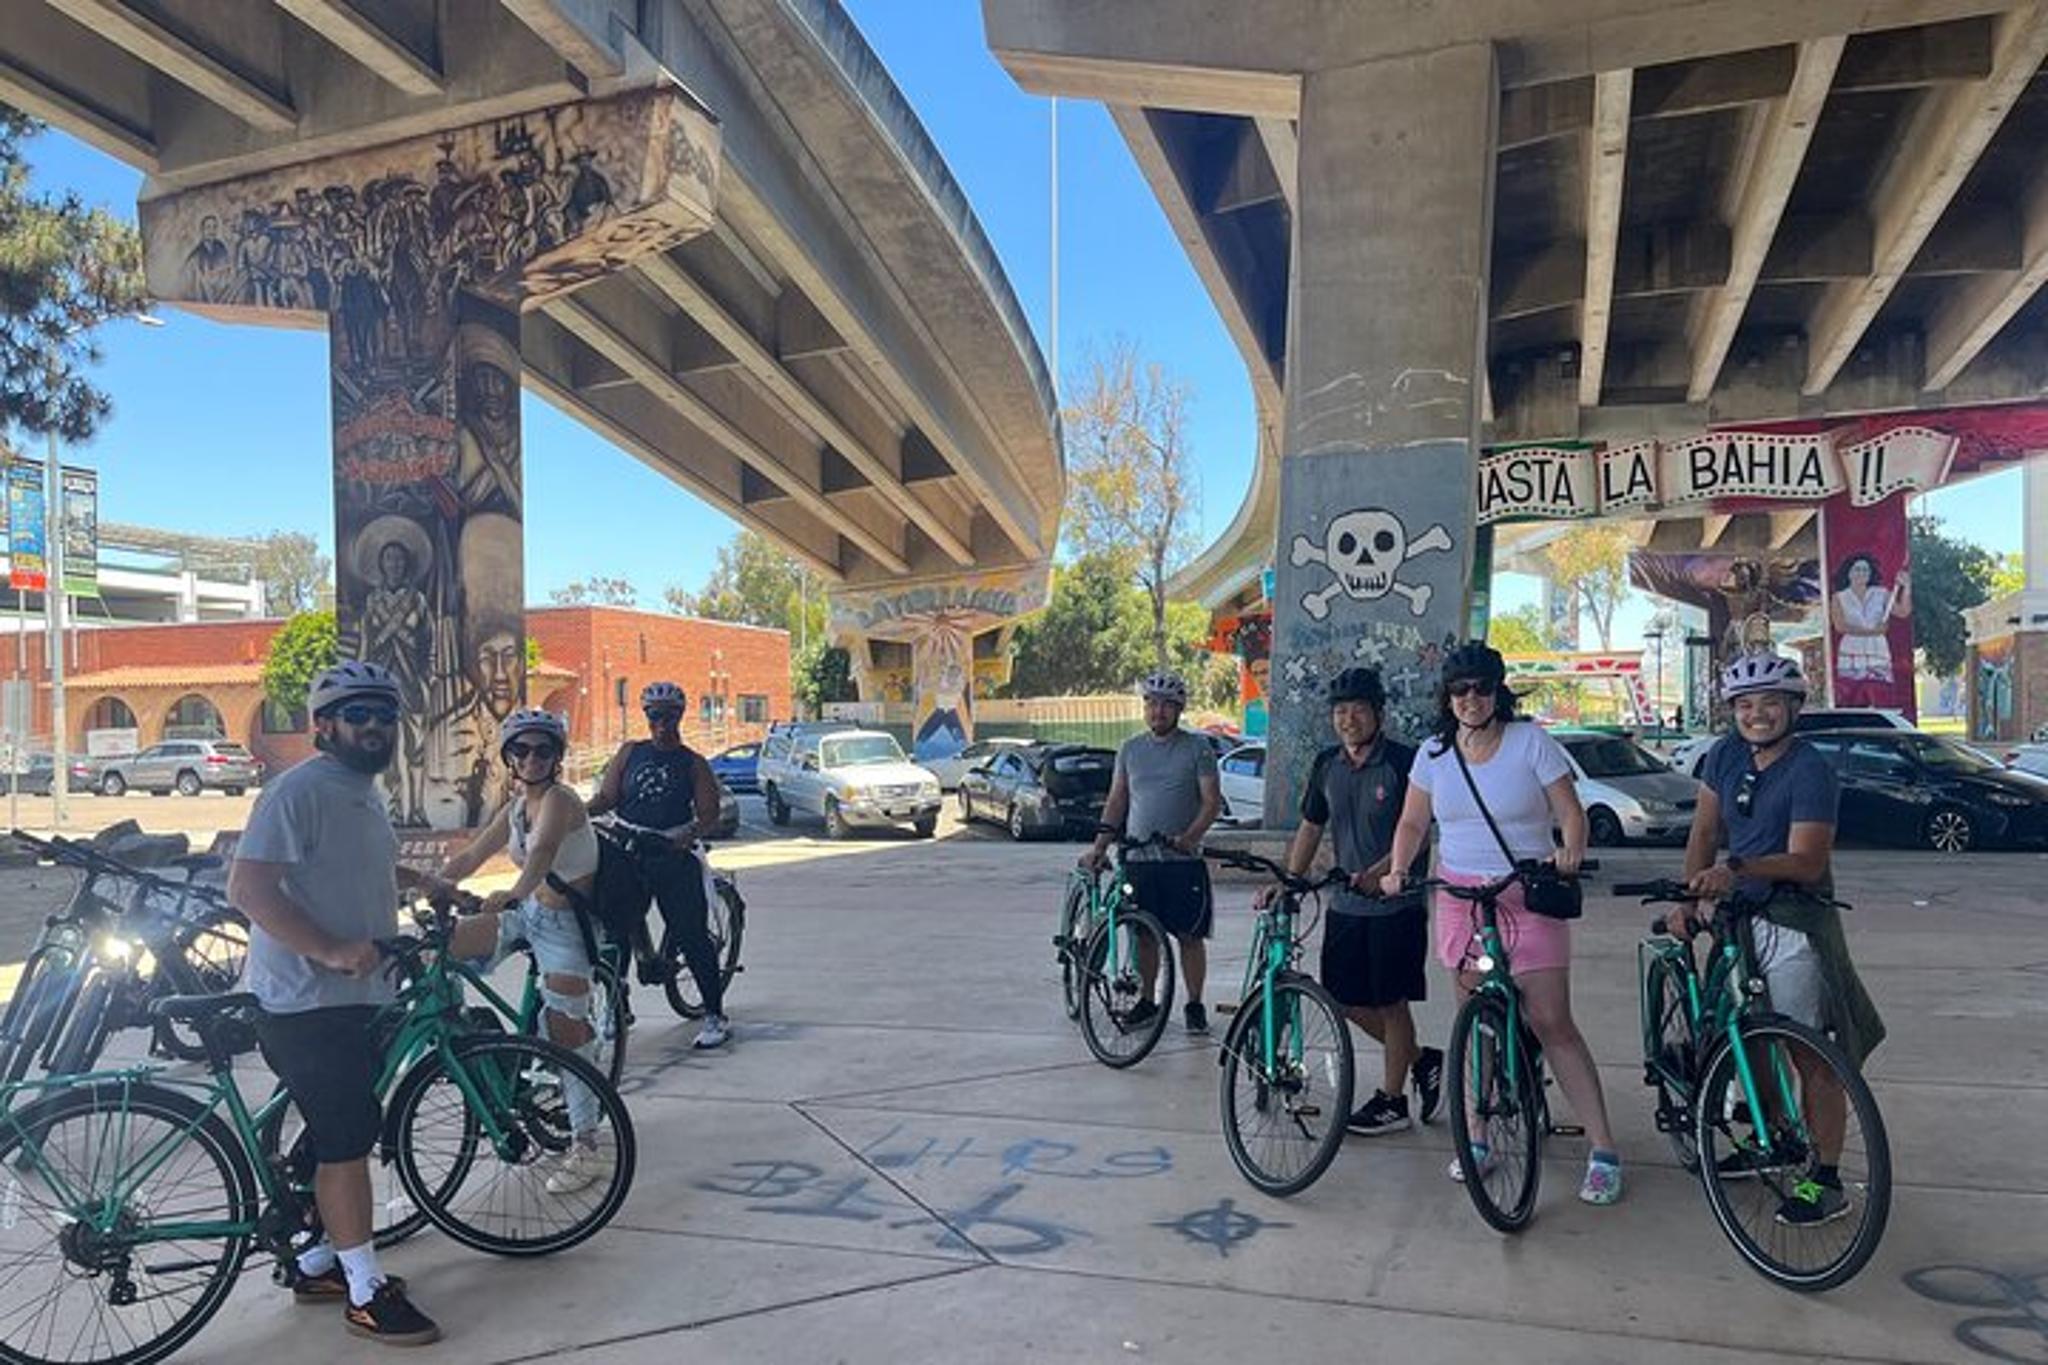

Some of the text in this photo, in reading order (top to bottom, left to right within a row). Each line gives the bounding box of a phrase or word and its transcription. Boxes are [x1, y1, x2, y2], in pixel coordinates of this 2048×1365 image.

[1603, 452, 1653, 501] LA
[1689, 442, 1825, 491] BAHIA
[1860, 446, 1886, 496] !!
